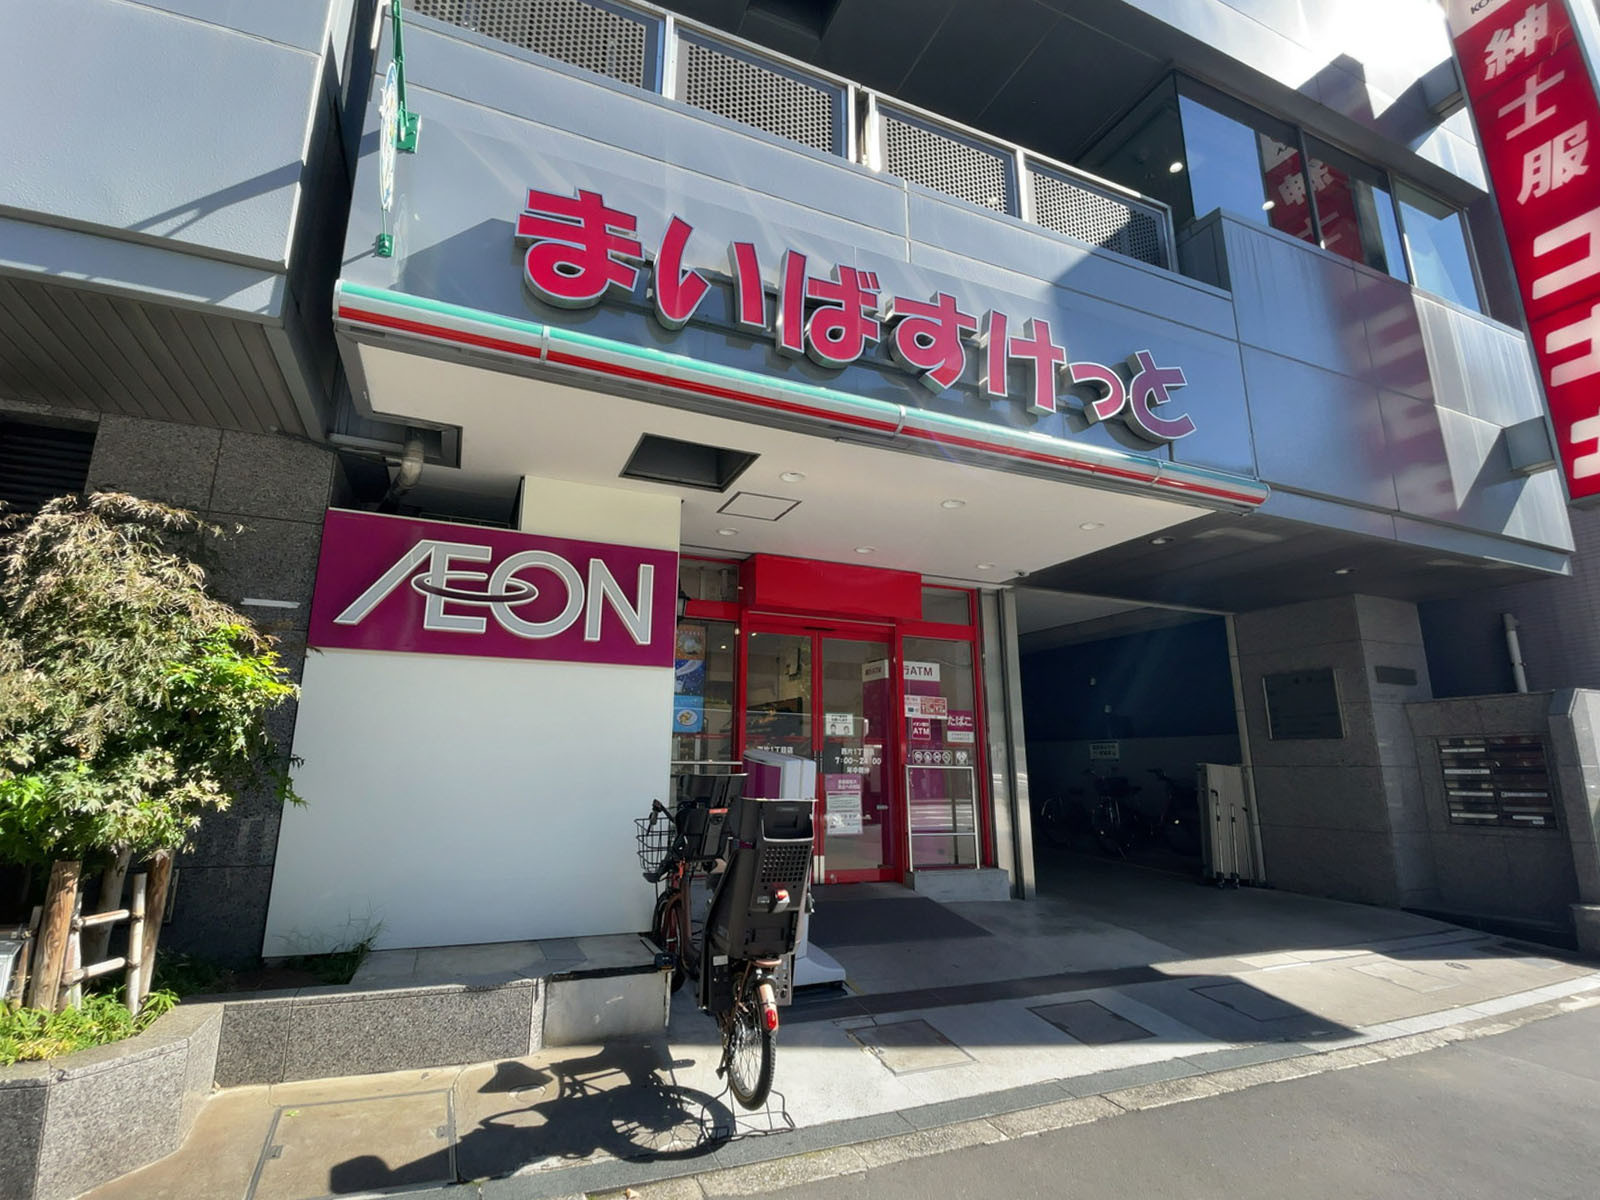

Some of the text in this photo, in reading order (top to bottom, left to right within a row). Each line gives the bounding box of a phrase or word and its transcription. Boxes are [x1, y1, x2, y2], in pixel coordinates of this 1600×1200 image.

[1484, 2, 1589, 206] 紳士服
[514, 187, 1196, 441] まいばすけっと
[912, 727, 930, 735] ATM
[947, 714, 973, 727] たばこ
